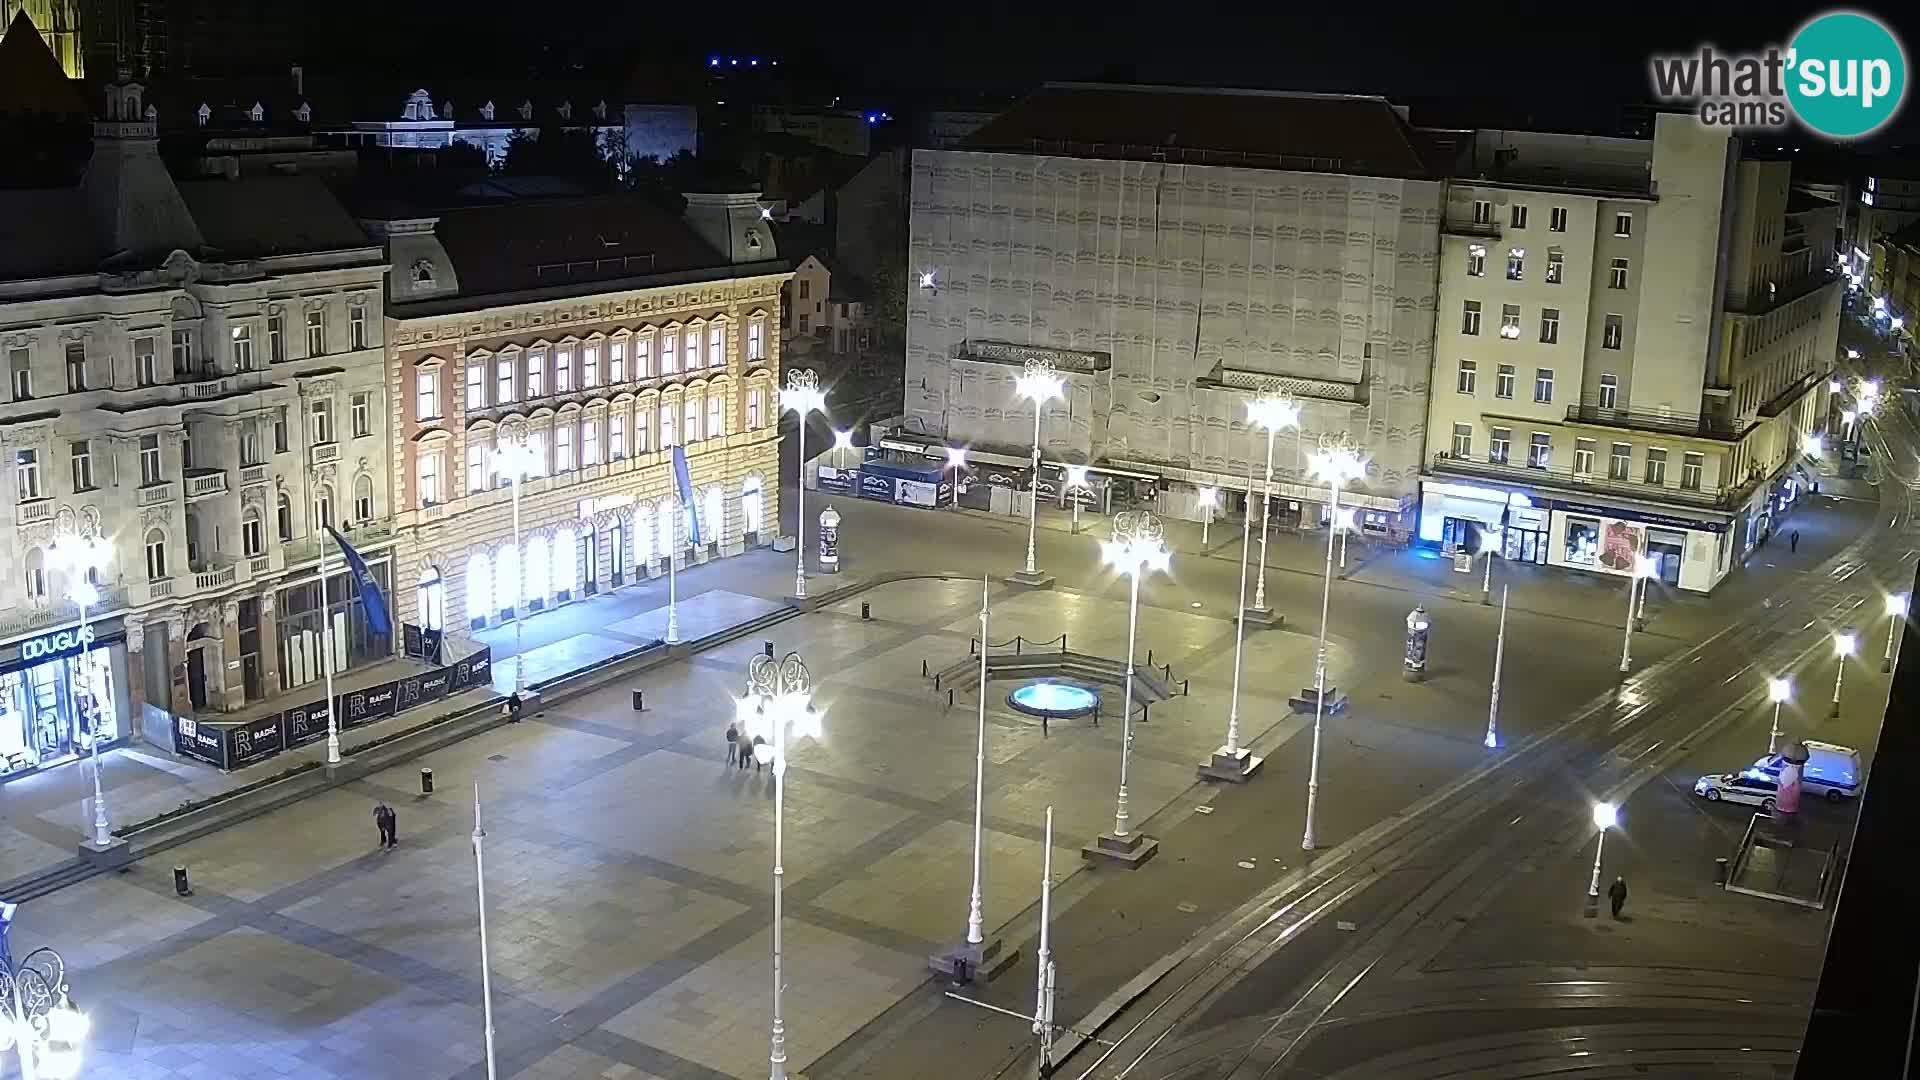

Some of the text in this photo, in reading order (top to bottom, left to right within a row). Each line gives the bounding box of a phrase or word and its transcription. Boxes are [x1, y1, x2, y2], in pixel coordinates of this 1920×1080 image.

[22, 624, 95, 661] DOUGLAS
[350, 694, 367, 717] R
[292, 710, 309, 735] R
[235, 730, 253, 759] R
